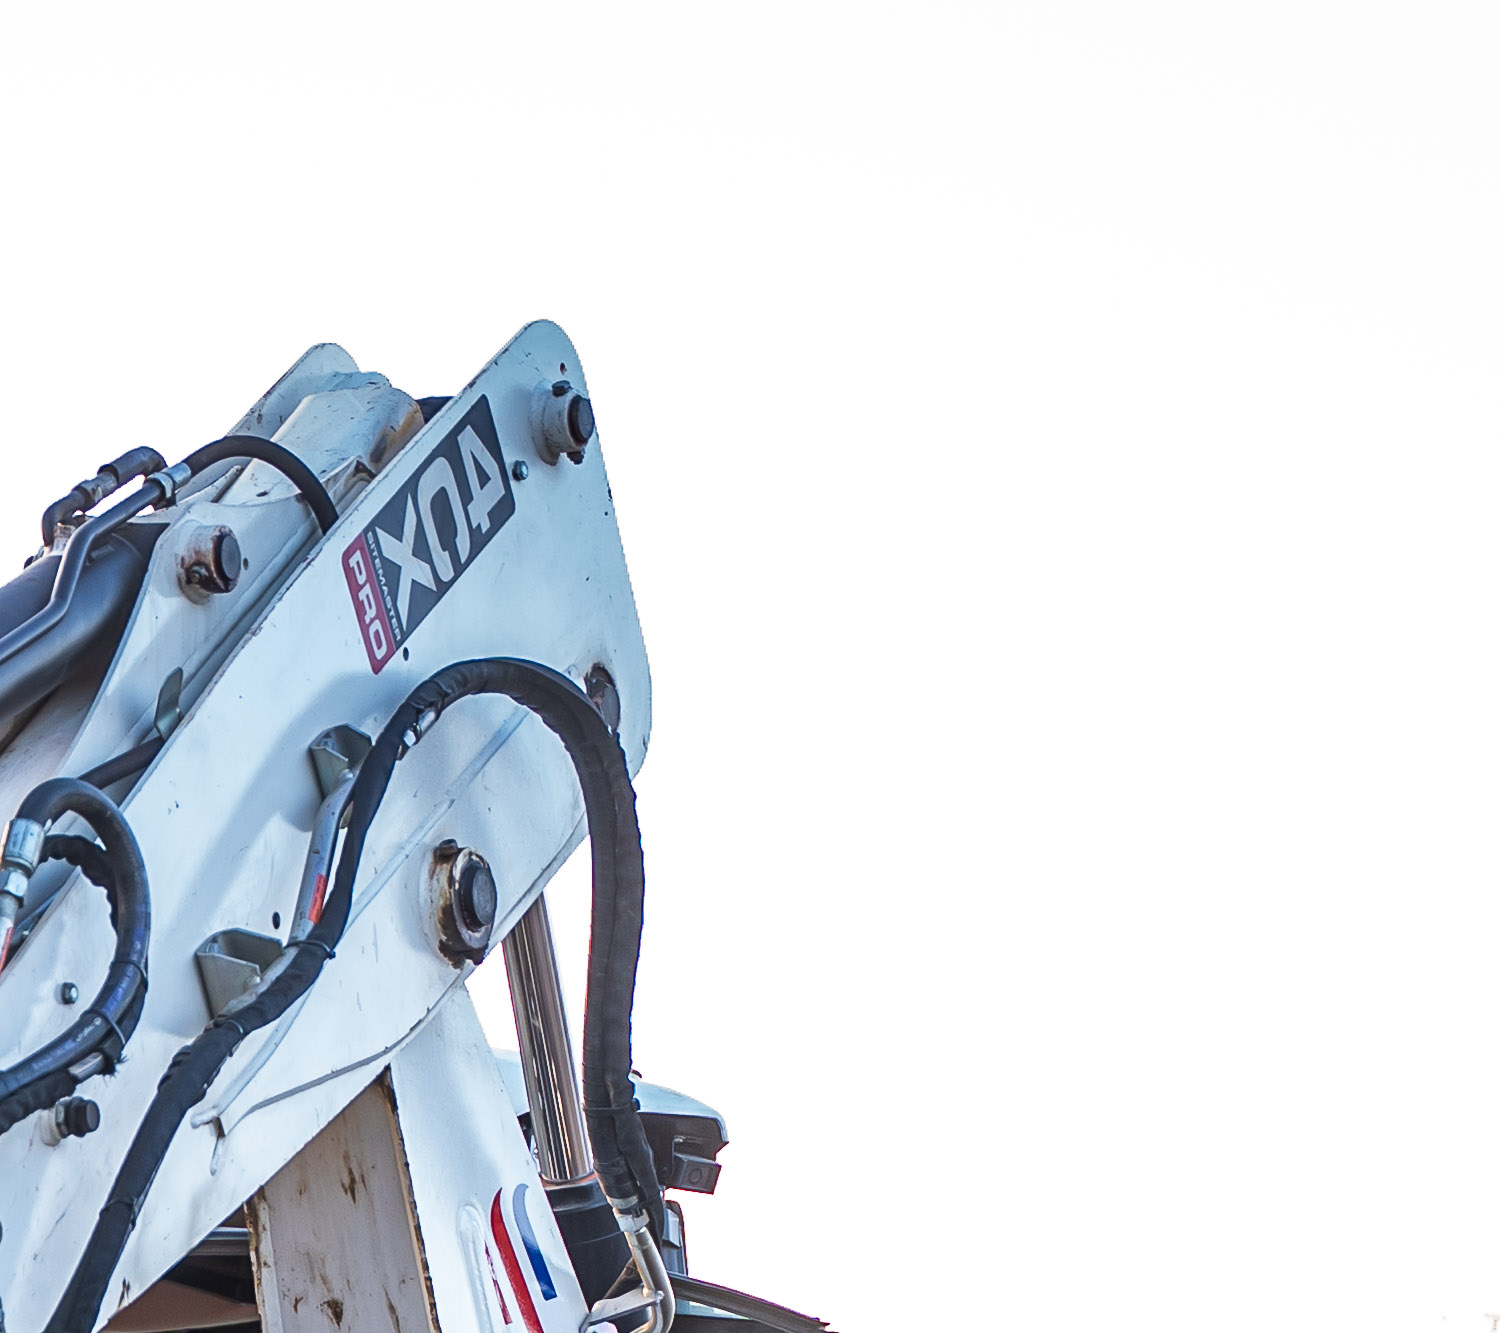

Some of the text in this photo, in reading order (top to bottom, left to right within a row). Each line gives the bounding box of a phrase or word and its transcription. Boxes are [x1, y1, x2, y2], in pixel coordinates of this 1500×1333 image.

[375, 424, 506, 632] 4CX
[348, 549, 388, 661] PRO
[366, 531, 402, 641] SITEMASTER
